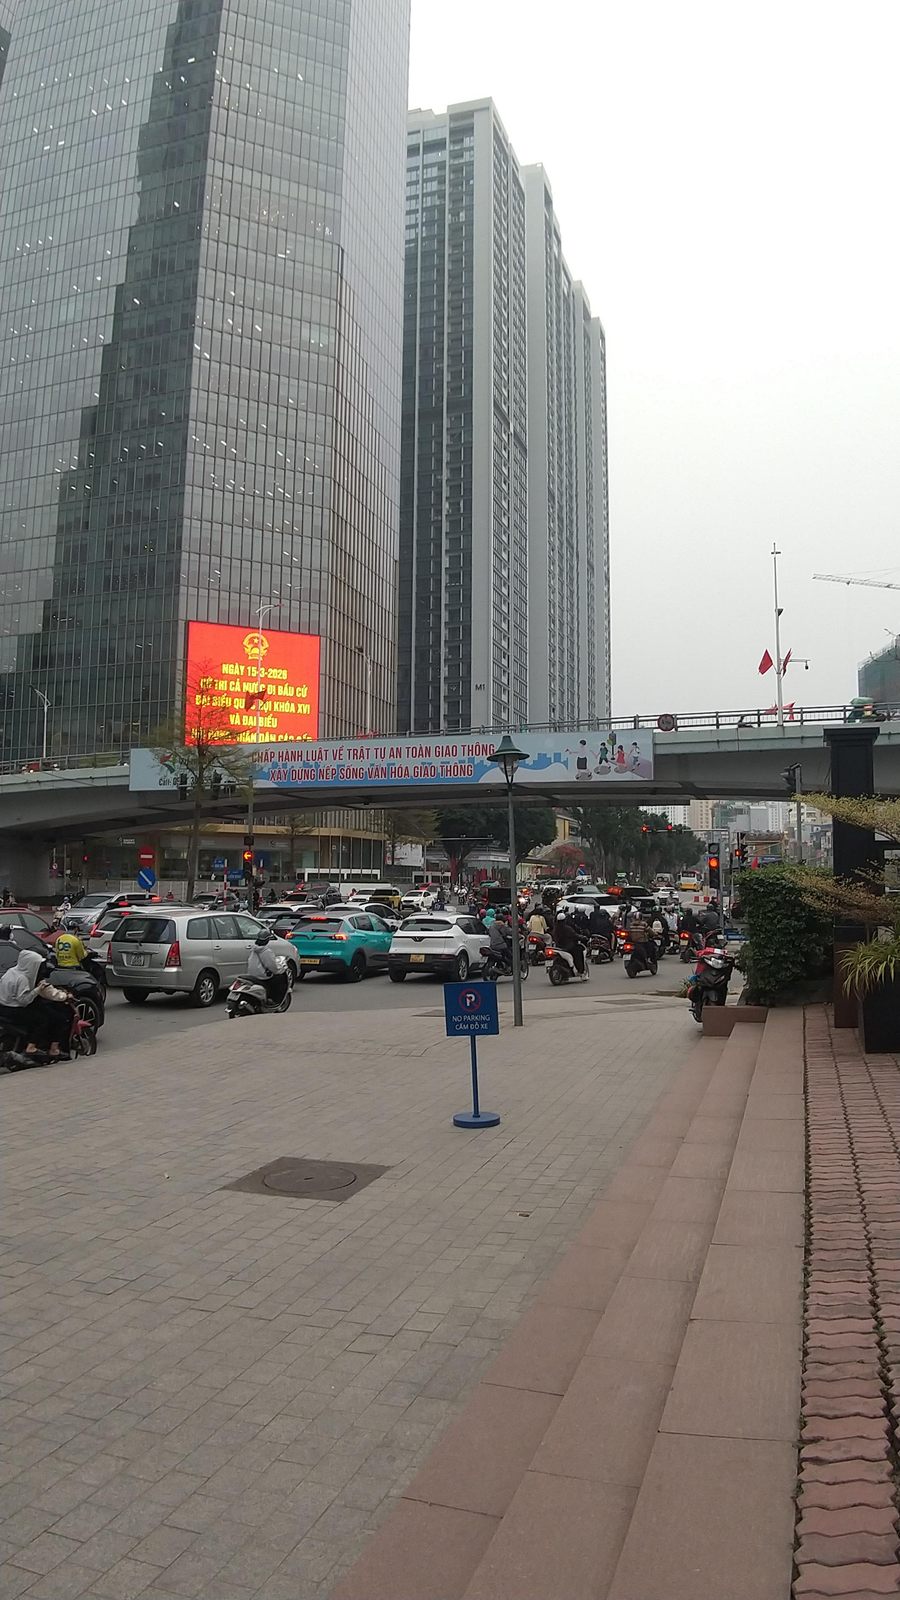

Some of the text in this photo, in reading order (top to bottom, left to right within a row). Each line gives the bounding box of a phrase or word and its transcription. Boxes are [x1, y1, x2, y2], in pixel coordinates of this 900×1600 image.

[222, 663, 244, 677] NGÀY
[230, 678, 241, 692] CẢ
[274, 700, 296, 713] KHÓA
[296, 703, 310, 714] XVI
[230, 712, 278, 728] VÀ ĐẠI BIỂU
[259, 732, 276, 742] DÂN
[278, 749, 303, 762] HÀNH
[306, 747, 328, 764] LUẬT
[332, 745, 344, 760] VỀ
[346, 746, 370, 762] TRẬT
[374, 746, 386, 761] TỰ
[388, 747, 402, 759] AN
[406, 744, 432, 758] TOÀN
[434, 744, 458, 758] GIAO
[460, 742, 496, 756] THÔNG
[270, 762, 473, 783] XÂY DỰNG NẾP SỐNG VĂN HÓA GIAO THÔNG
[57, 939, 71, 951] be
